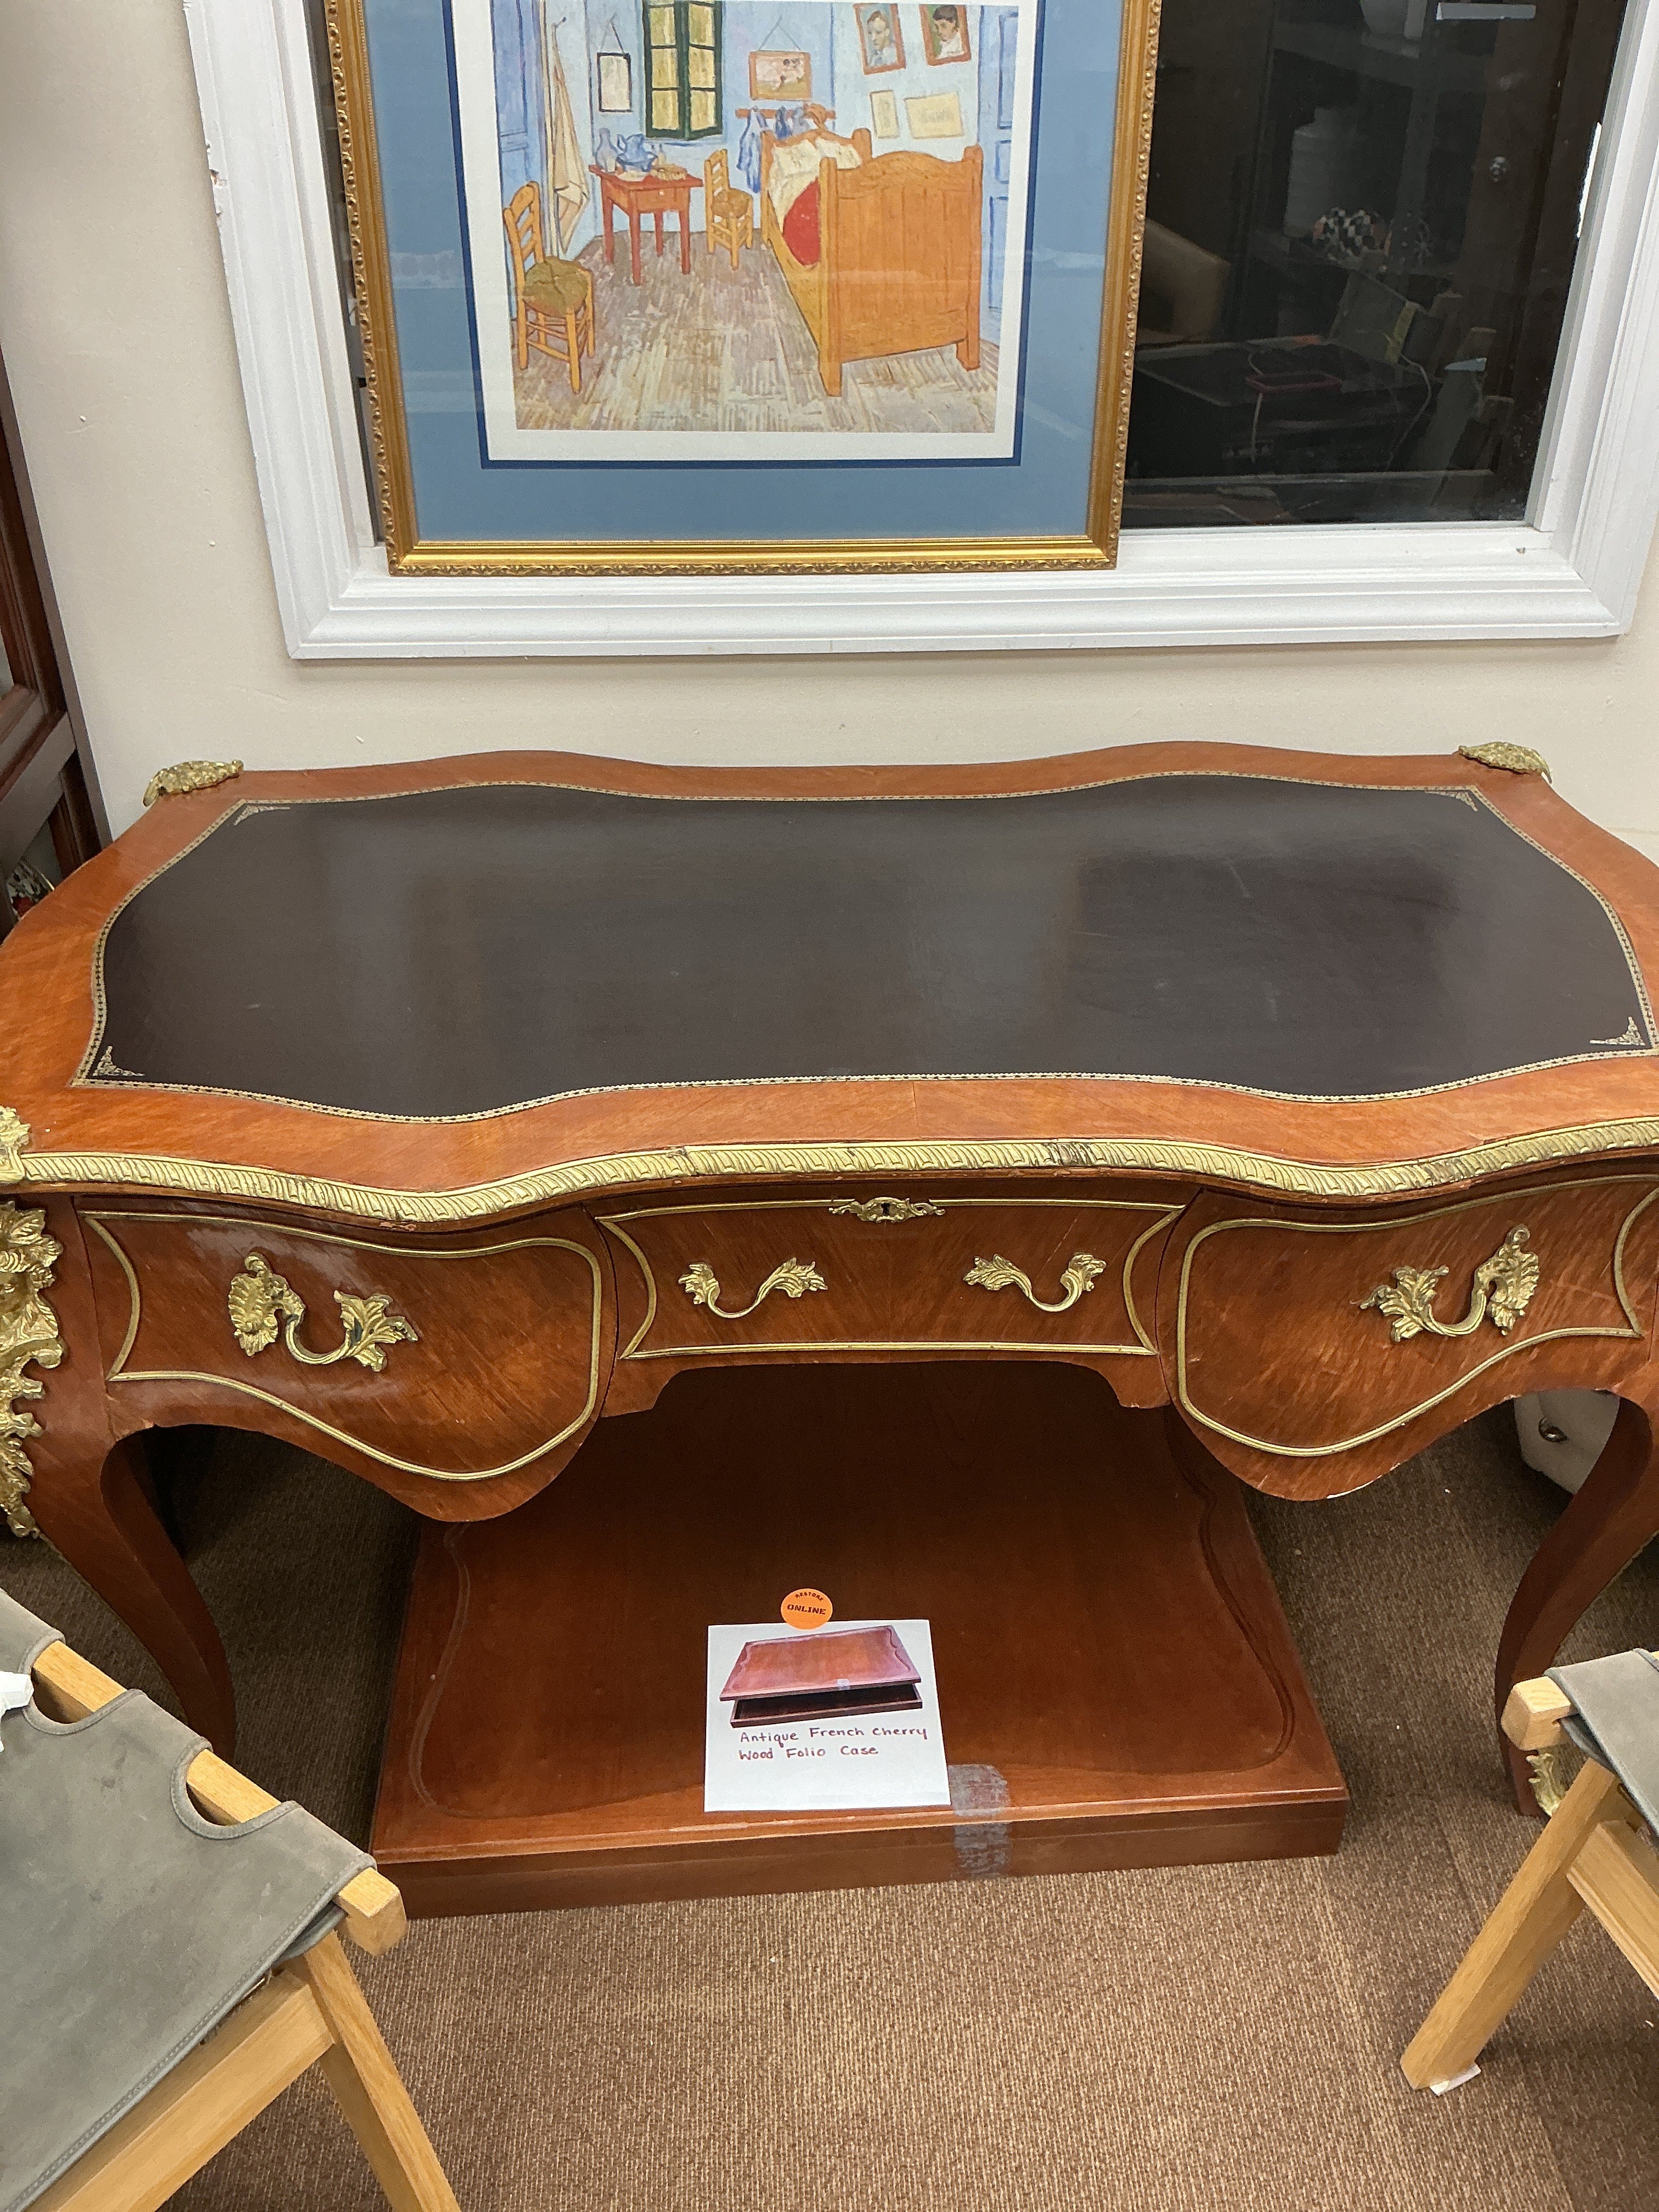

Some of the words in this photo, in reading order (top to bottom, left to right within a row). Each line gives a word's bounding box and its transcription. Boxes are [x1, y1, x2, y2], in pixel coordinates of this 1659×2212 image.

[787, 1604, 827, 1615] ONLINE
[741, 1731, 799, 1748] Antique
[809, 1727, 865, 1737] French
[872, 1728, 927, 1740] Cherry
[738, 1747, 774, 1760] Wood
[786, 1747, 826, 1758] Folio
[840, 1745, 878, 1755] Case
